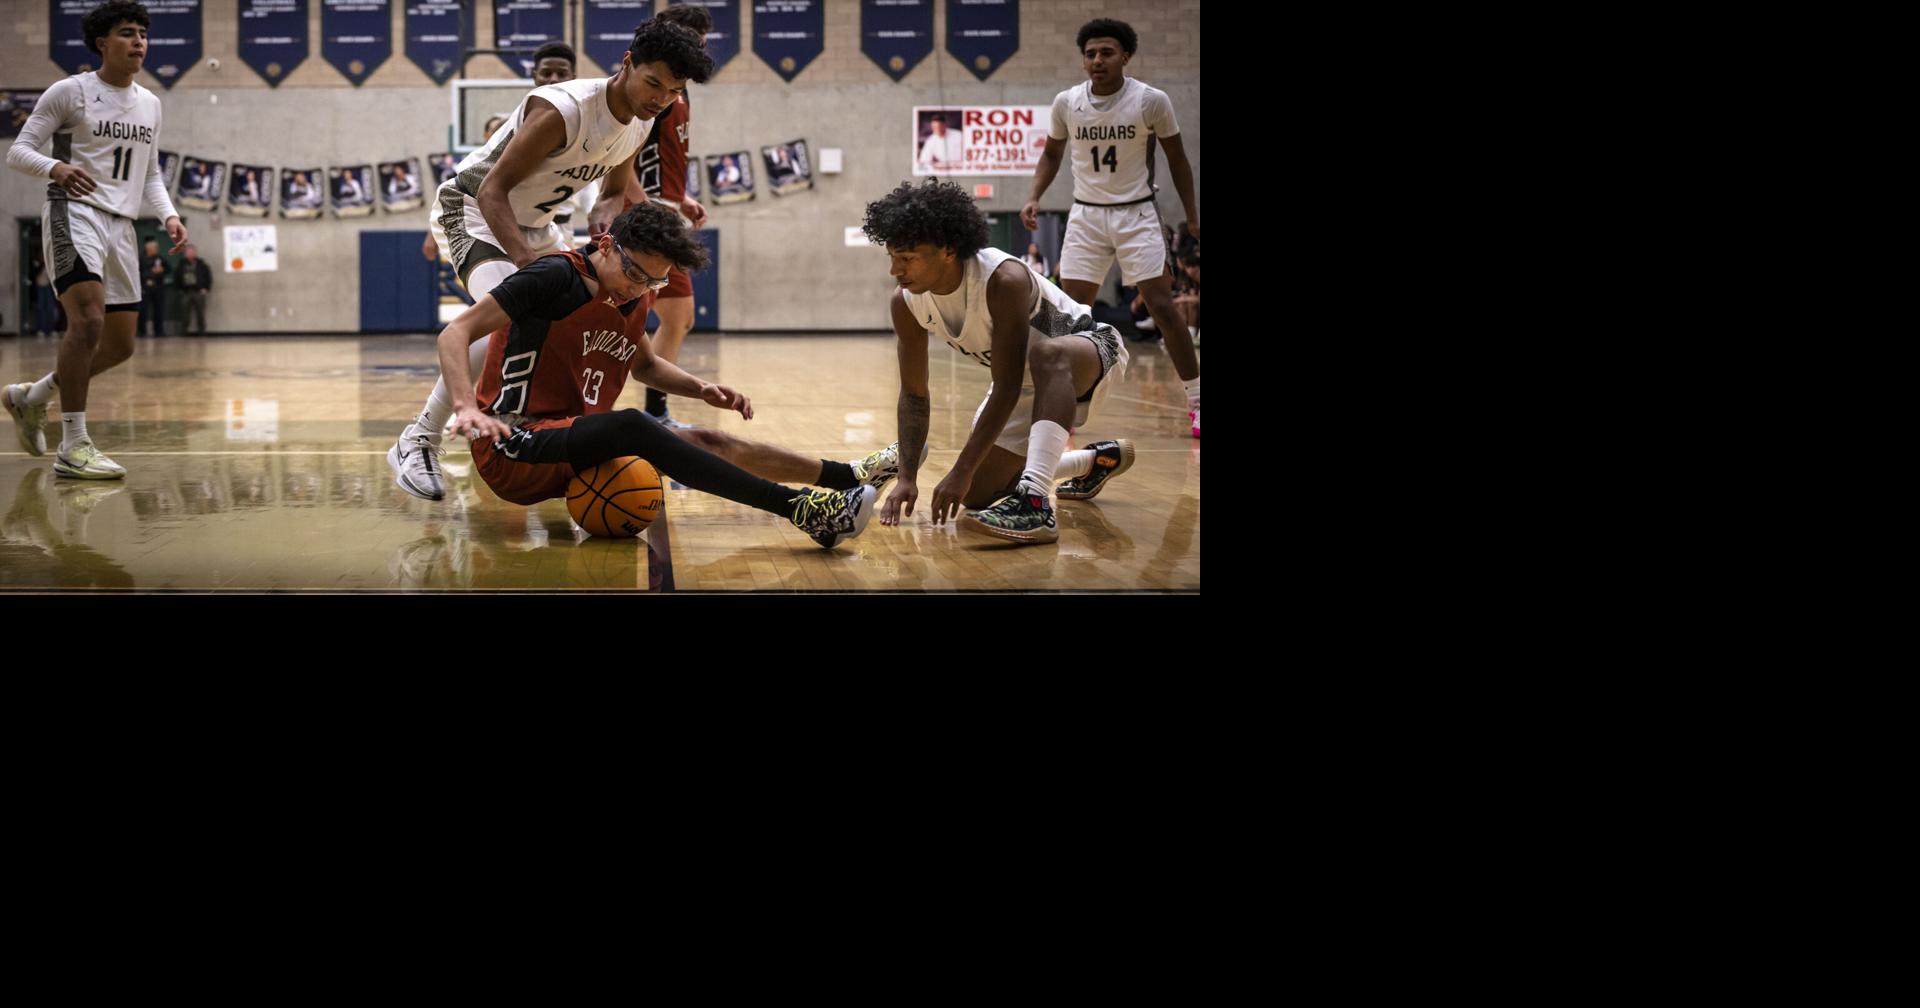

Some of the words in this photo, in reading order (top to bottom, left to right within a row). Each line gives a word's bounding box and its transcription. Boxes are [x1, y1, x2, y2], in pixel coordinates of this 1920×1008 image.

[964, 110, 1033, 126] RON
[93, 120, 152, 144] JAGUARS
[972, 128, 1023, 145] PINO
[1075, 125, 1136, 140] JAGUARS
[112, 146, 132, 181] 11
[966, 148, 1026, 161] 877-1391
[1091, 145, 1117, 173] 14
[533, 186, 574, 213] 2
[582, 367, 604, 406] 23
